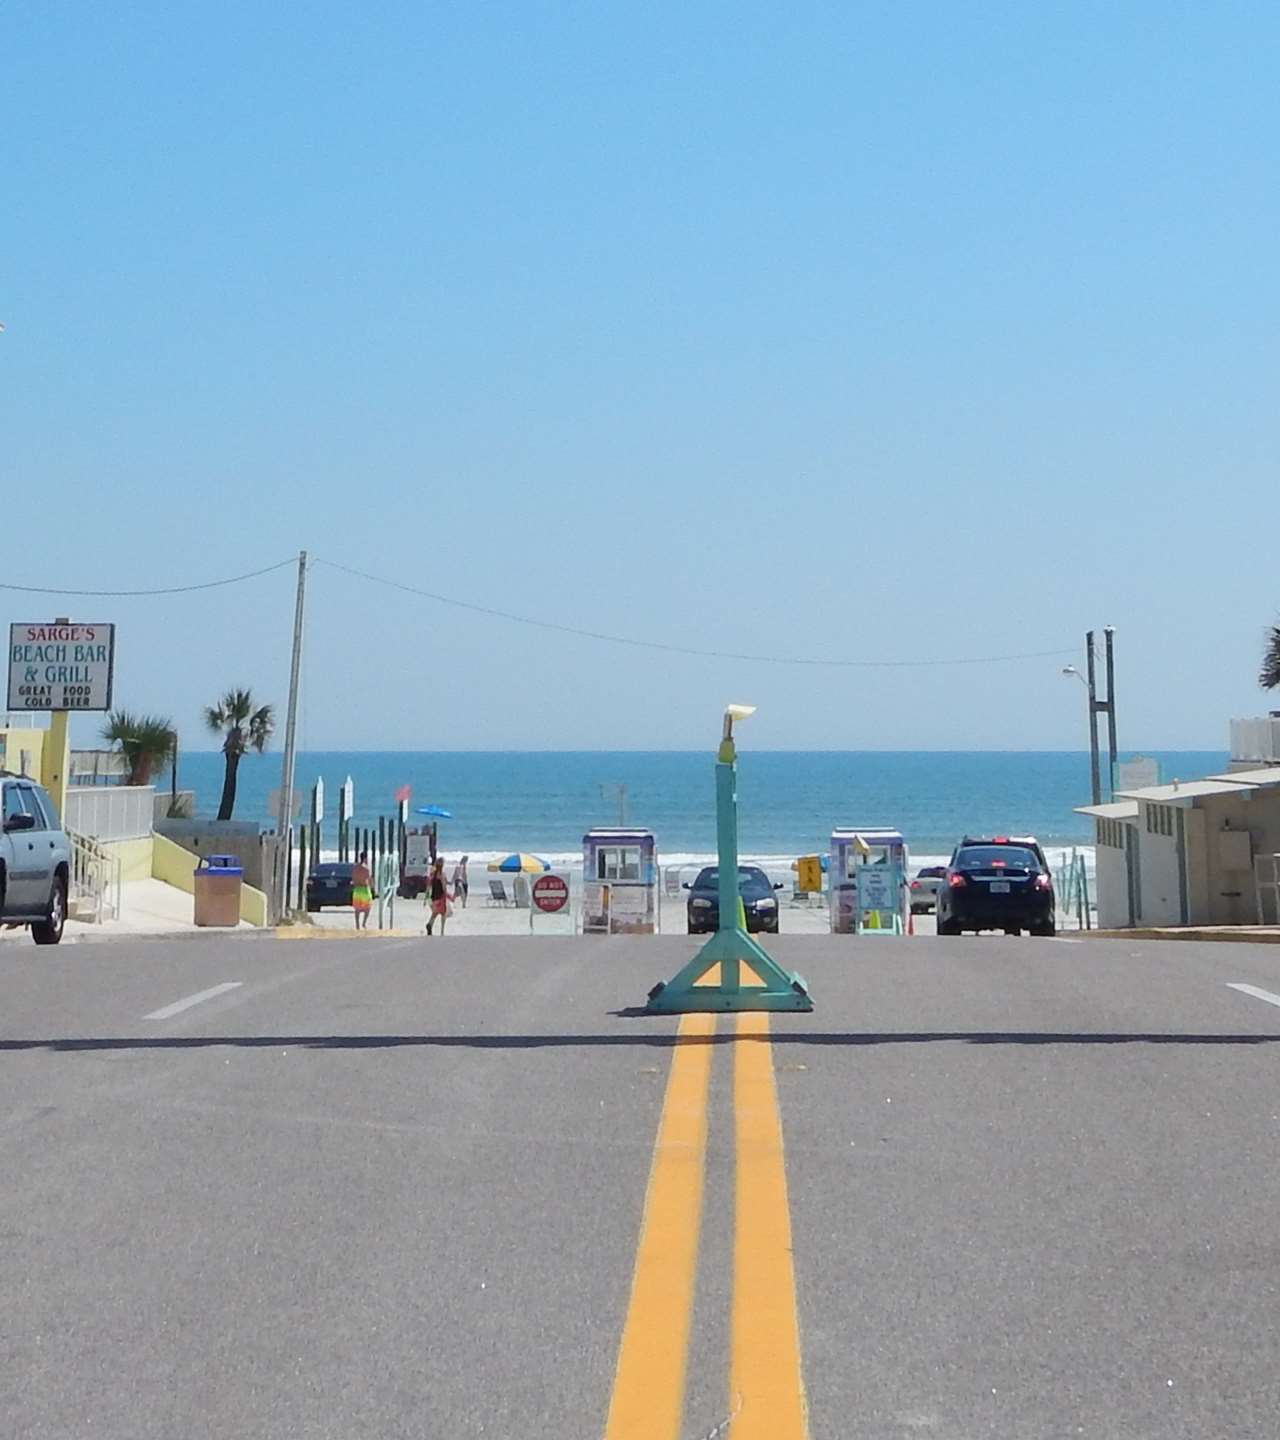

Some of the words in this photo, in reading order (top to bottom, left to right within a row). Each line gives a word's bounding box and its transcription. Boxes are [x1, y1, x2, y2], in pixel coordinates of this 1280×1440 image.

[27, 628, 95, 641] SARGE'S
[13, 645, 66, 662] BEACH
[74, 645, 106, 662] BAR
[24, 665, 38, 683] &
[45, 665, 93, 683] GRILL
[18, 686, 52, 696] GREAT
[63, 686, 91, 696] FOOD
[25, 697, 52, 707] COLD
[63, 697, 90, 707] BEER
